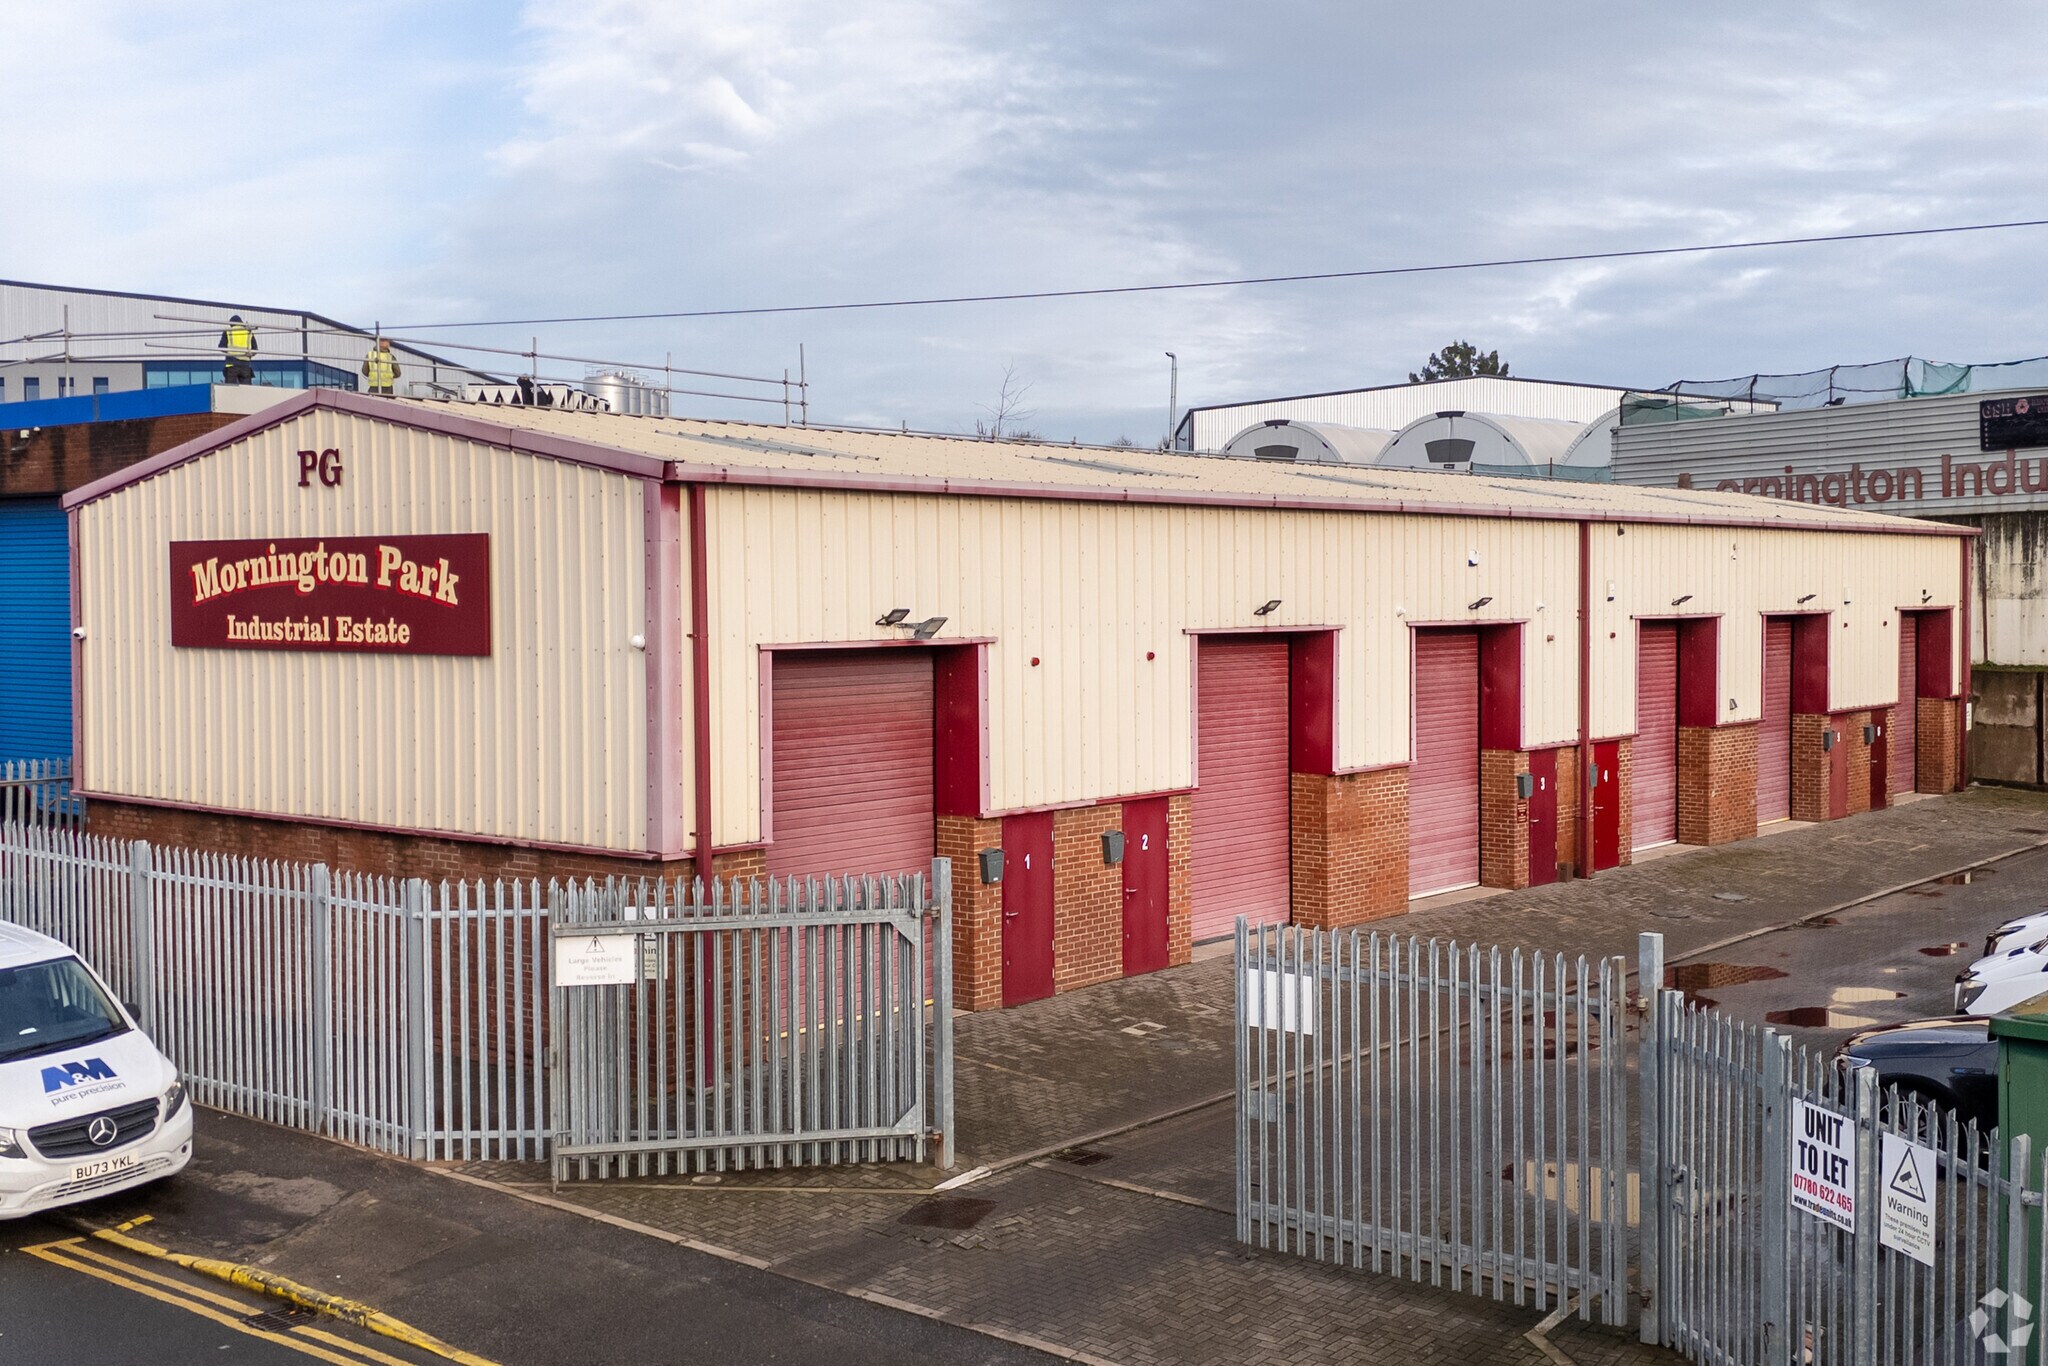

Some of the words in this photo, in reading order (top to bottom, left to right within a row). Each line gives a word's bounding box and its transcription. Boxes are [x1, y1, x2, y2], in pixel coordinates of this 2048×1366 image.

[297, 448, 343, 487] PG
[191, 542, 369, 602] Mornington
[377, 545, 460, 606] Park
[227, 614, 331, 642] Industrial
[336, 616, 411, 644] Estate
[1540, 776, 1546, 791] 3
[1603, 769, 1609, 783] 4
[1141, 833, 1149, 851] 2
[1024, 853, 1031, 870] 1
[50, 1093, 77, 1107] pure
[79, 1081, 126, 1099] precision
[1805, 1106, 1843, 1149] UNIT
[76, 1162, 109, 1179] BU73
[111, 1155, 134, 1170] YKL
[1798, 1139, 1818, 1176] TO
[1823, 1149, 1848, 1189] LET
[1794, 1173, 1818, 1196] 07780
[1819, 1184, 1835, 1205] 622
[1836, 1193, 1852, 1213] 465
[1794, 1194, 1852, 1228] www.tradeunits.co.uk
[1887, 1196, 1929, 1228] Warning
[1917, 1235, 1931, 1247] CCTV
